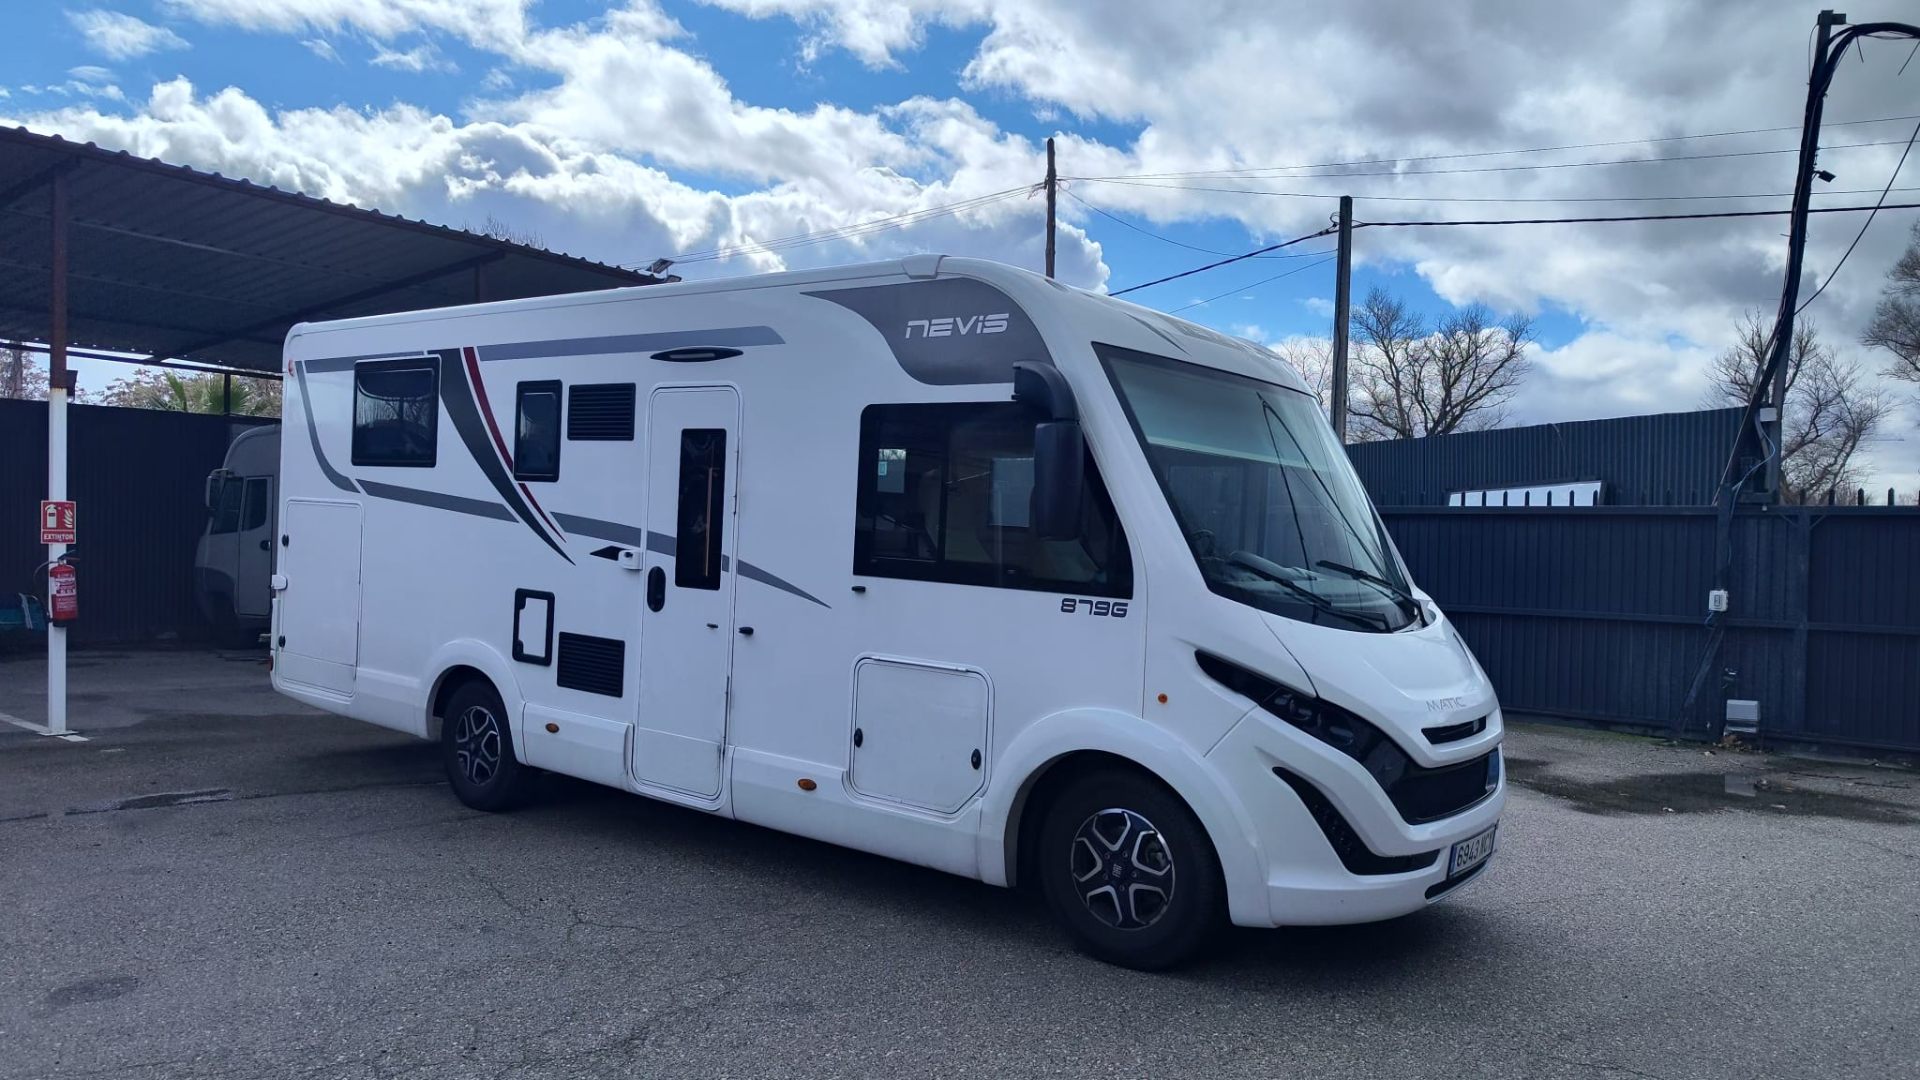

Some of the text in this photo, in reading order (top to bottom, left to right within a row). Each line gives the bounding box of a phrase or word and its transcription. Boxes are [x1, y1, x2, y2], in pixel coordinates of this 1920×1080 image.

[43, 533, 74, 541] EXTINTOR
[1060, 597, 1129, 618] 879G
[1425, 697, 1467, 712] MATIC
[1456, 839, 1480, 868] 6943
